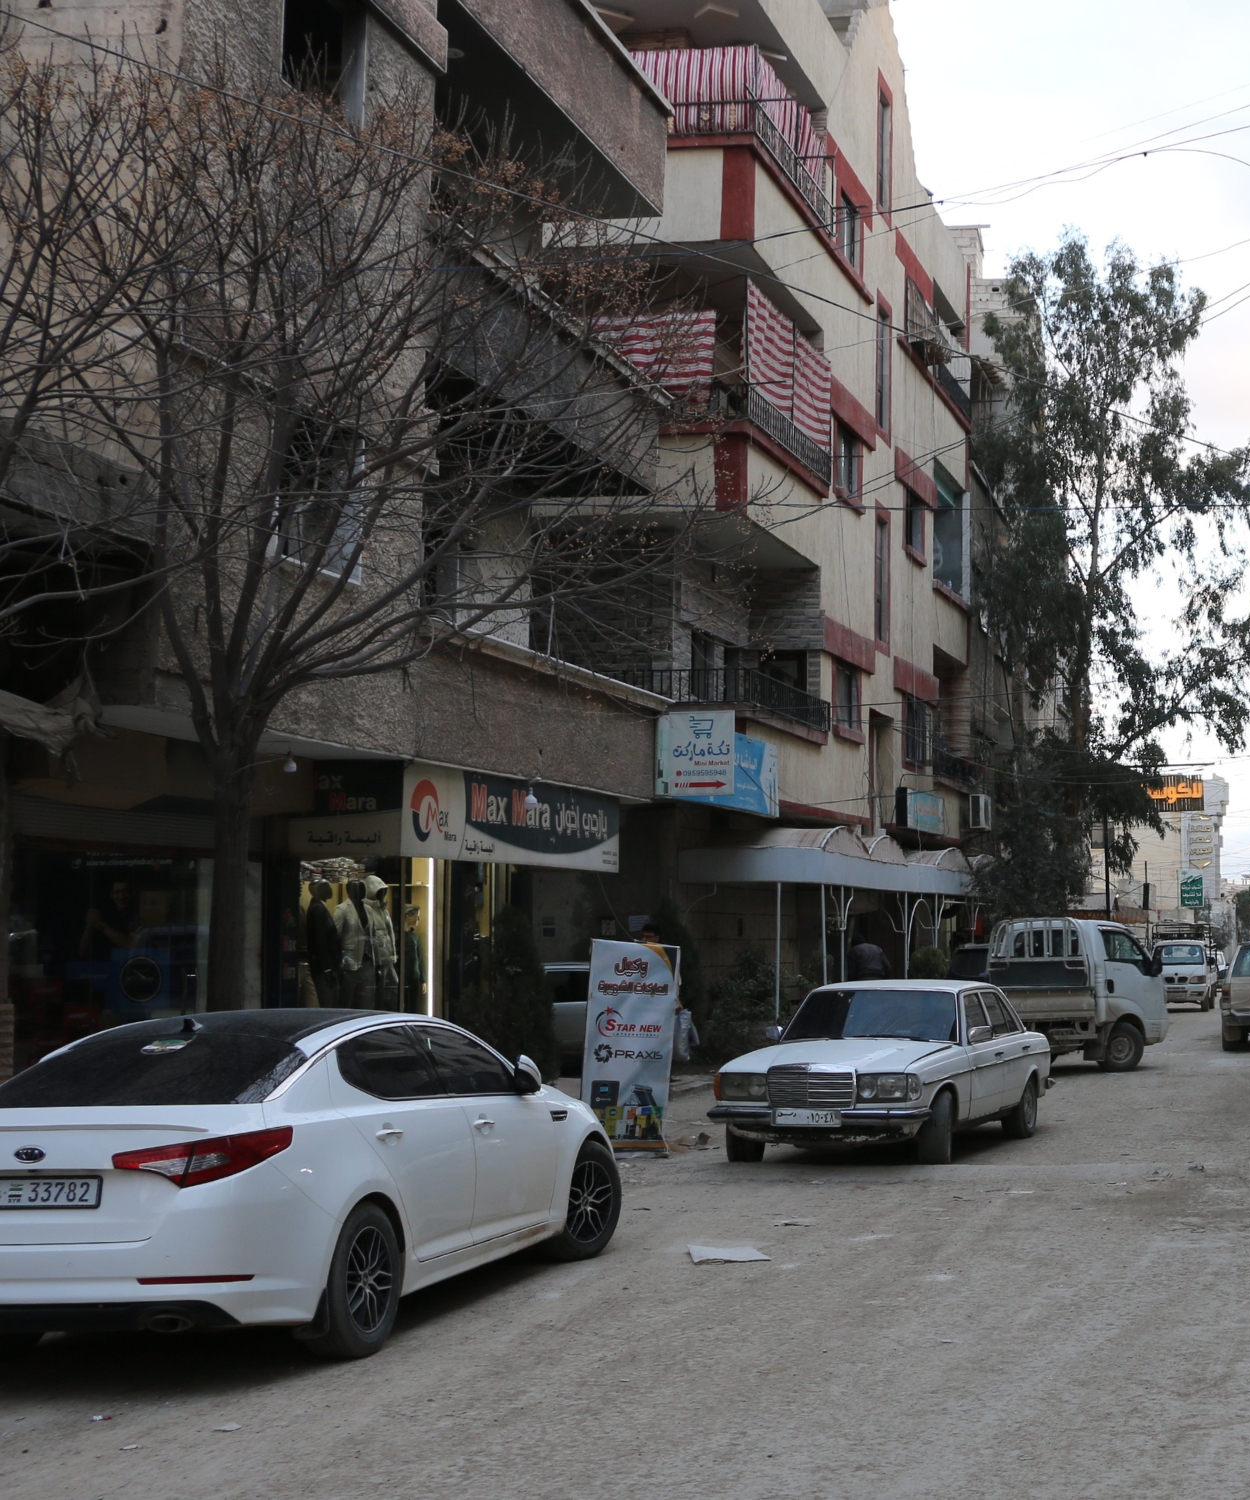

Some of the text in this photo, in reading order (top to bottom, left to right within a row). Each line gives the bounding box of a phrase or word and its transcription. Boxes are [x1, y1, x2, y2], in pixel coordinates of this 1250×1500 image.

[672, 740, 730, 761] تكة ماركت
[313, 771, 344, 790] ax
[682, 769, 727, 777] 0959595948
[329, 792, 377, 811] Mara
[471, 782, 551, 830] Max Mara
[307, 830, 343, 848] راقية
[614, 956, 649, 978] وكيل
[605, 1018, 662, 1032] STAR NEW
[614, 1050, 663, 1059] PRAXIS
[28, 1182, 90, 1202] 33782
